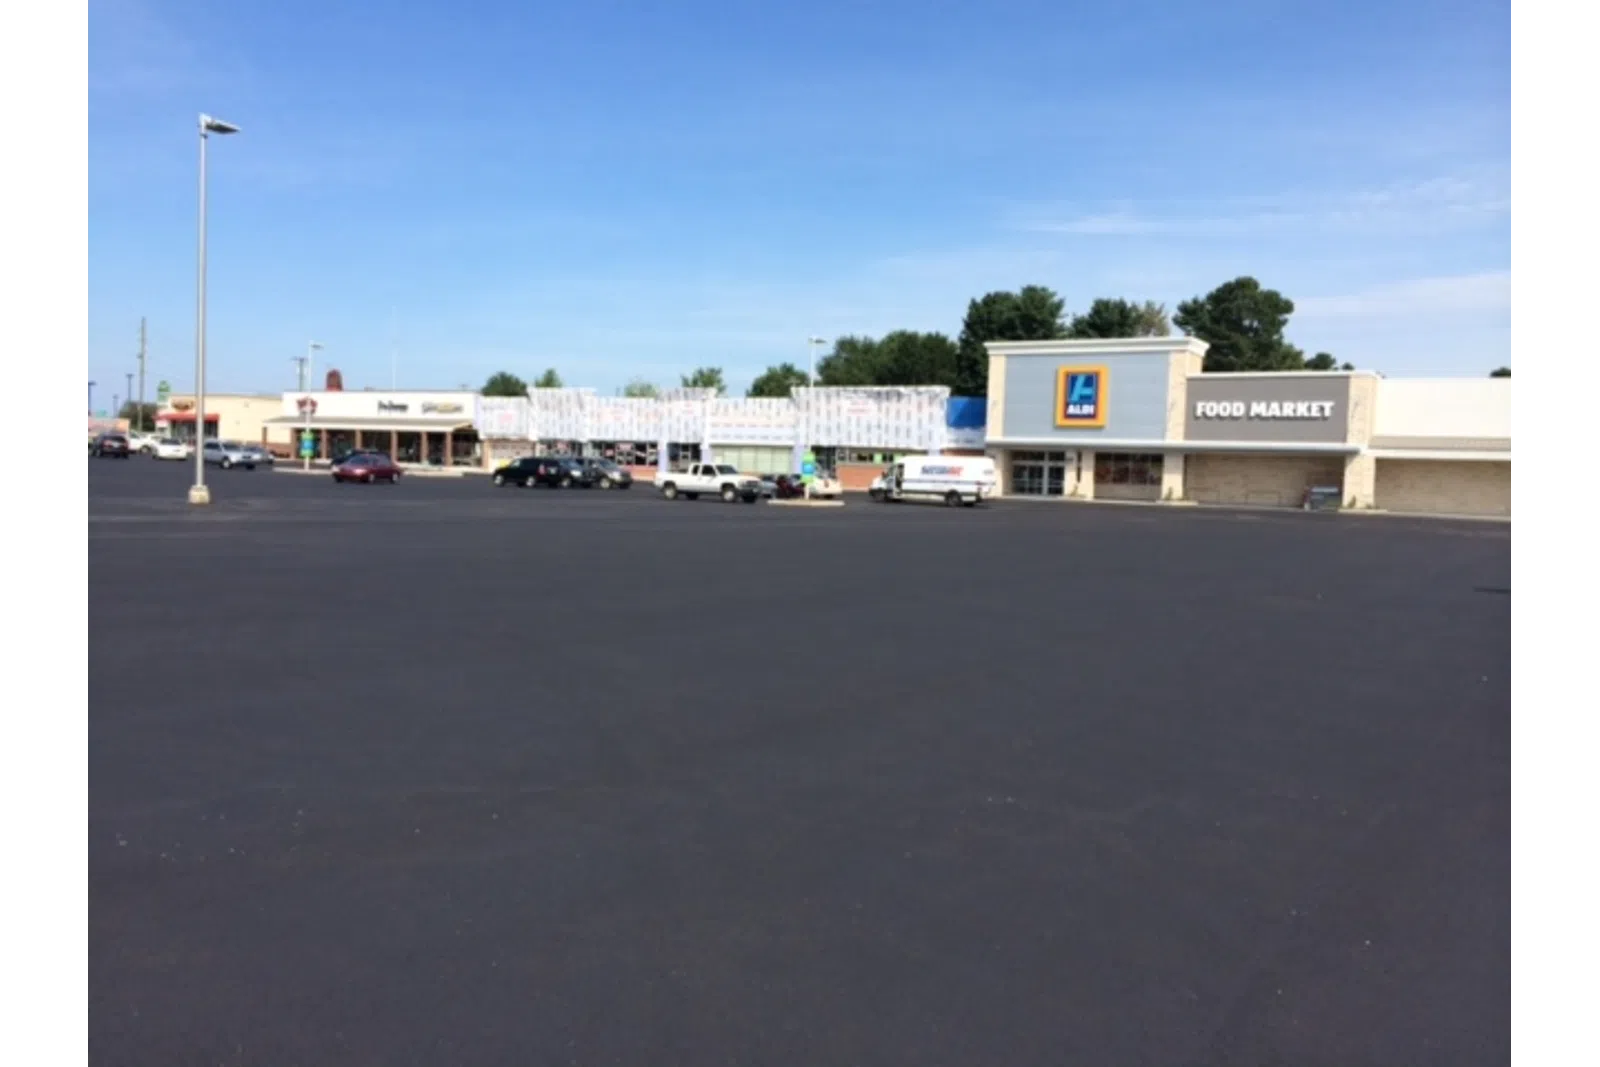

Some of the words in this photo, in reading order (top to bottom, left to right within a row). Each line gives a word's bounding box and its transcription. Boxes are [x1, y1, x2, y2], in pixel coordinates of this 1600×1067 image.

[1066, 403, 1095, 416] ALDI
[1195, 400, 1246, 418] FOOD
[1249, 400, 1335, 418] MARKET
